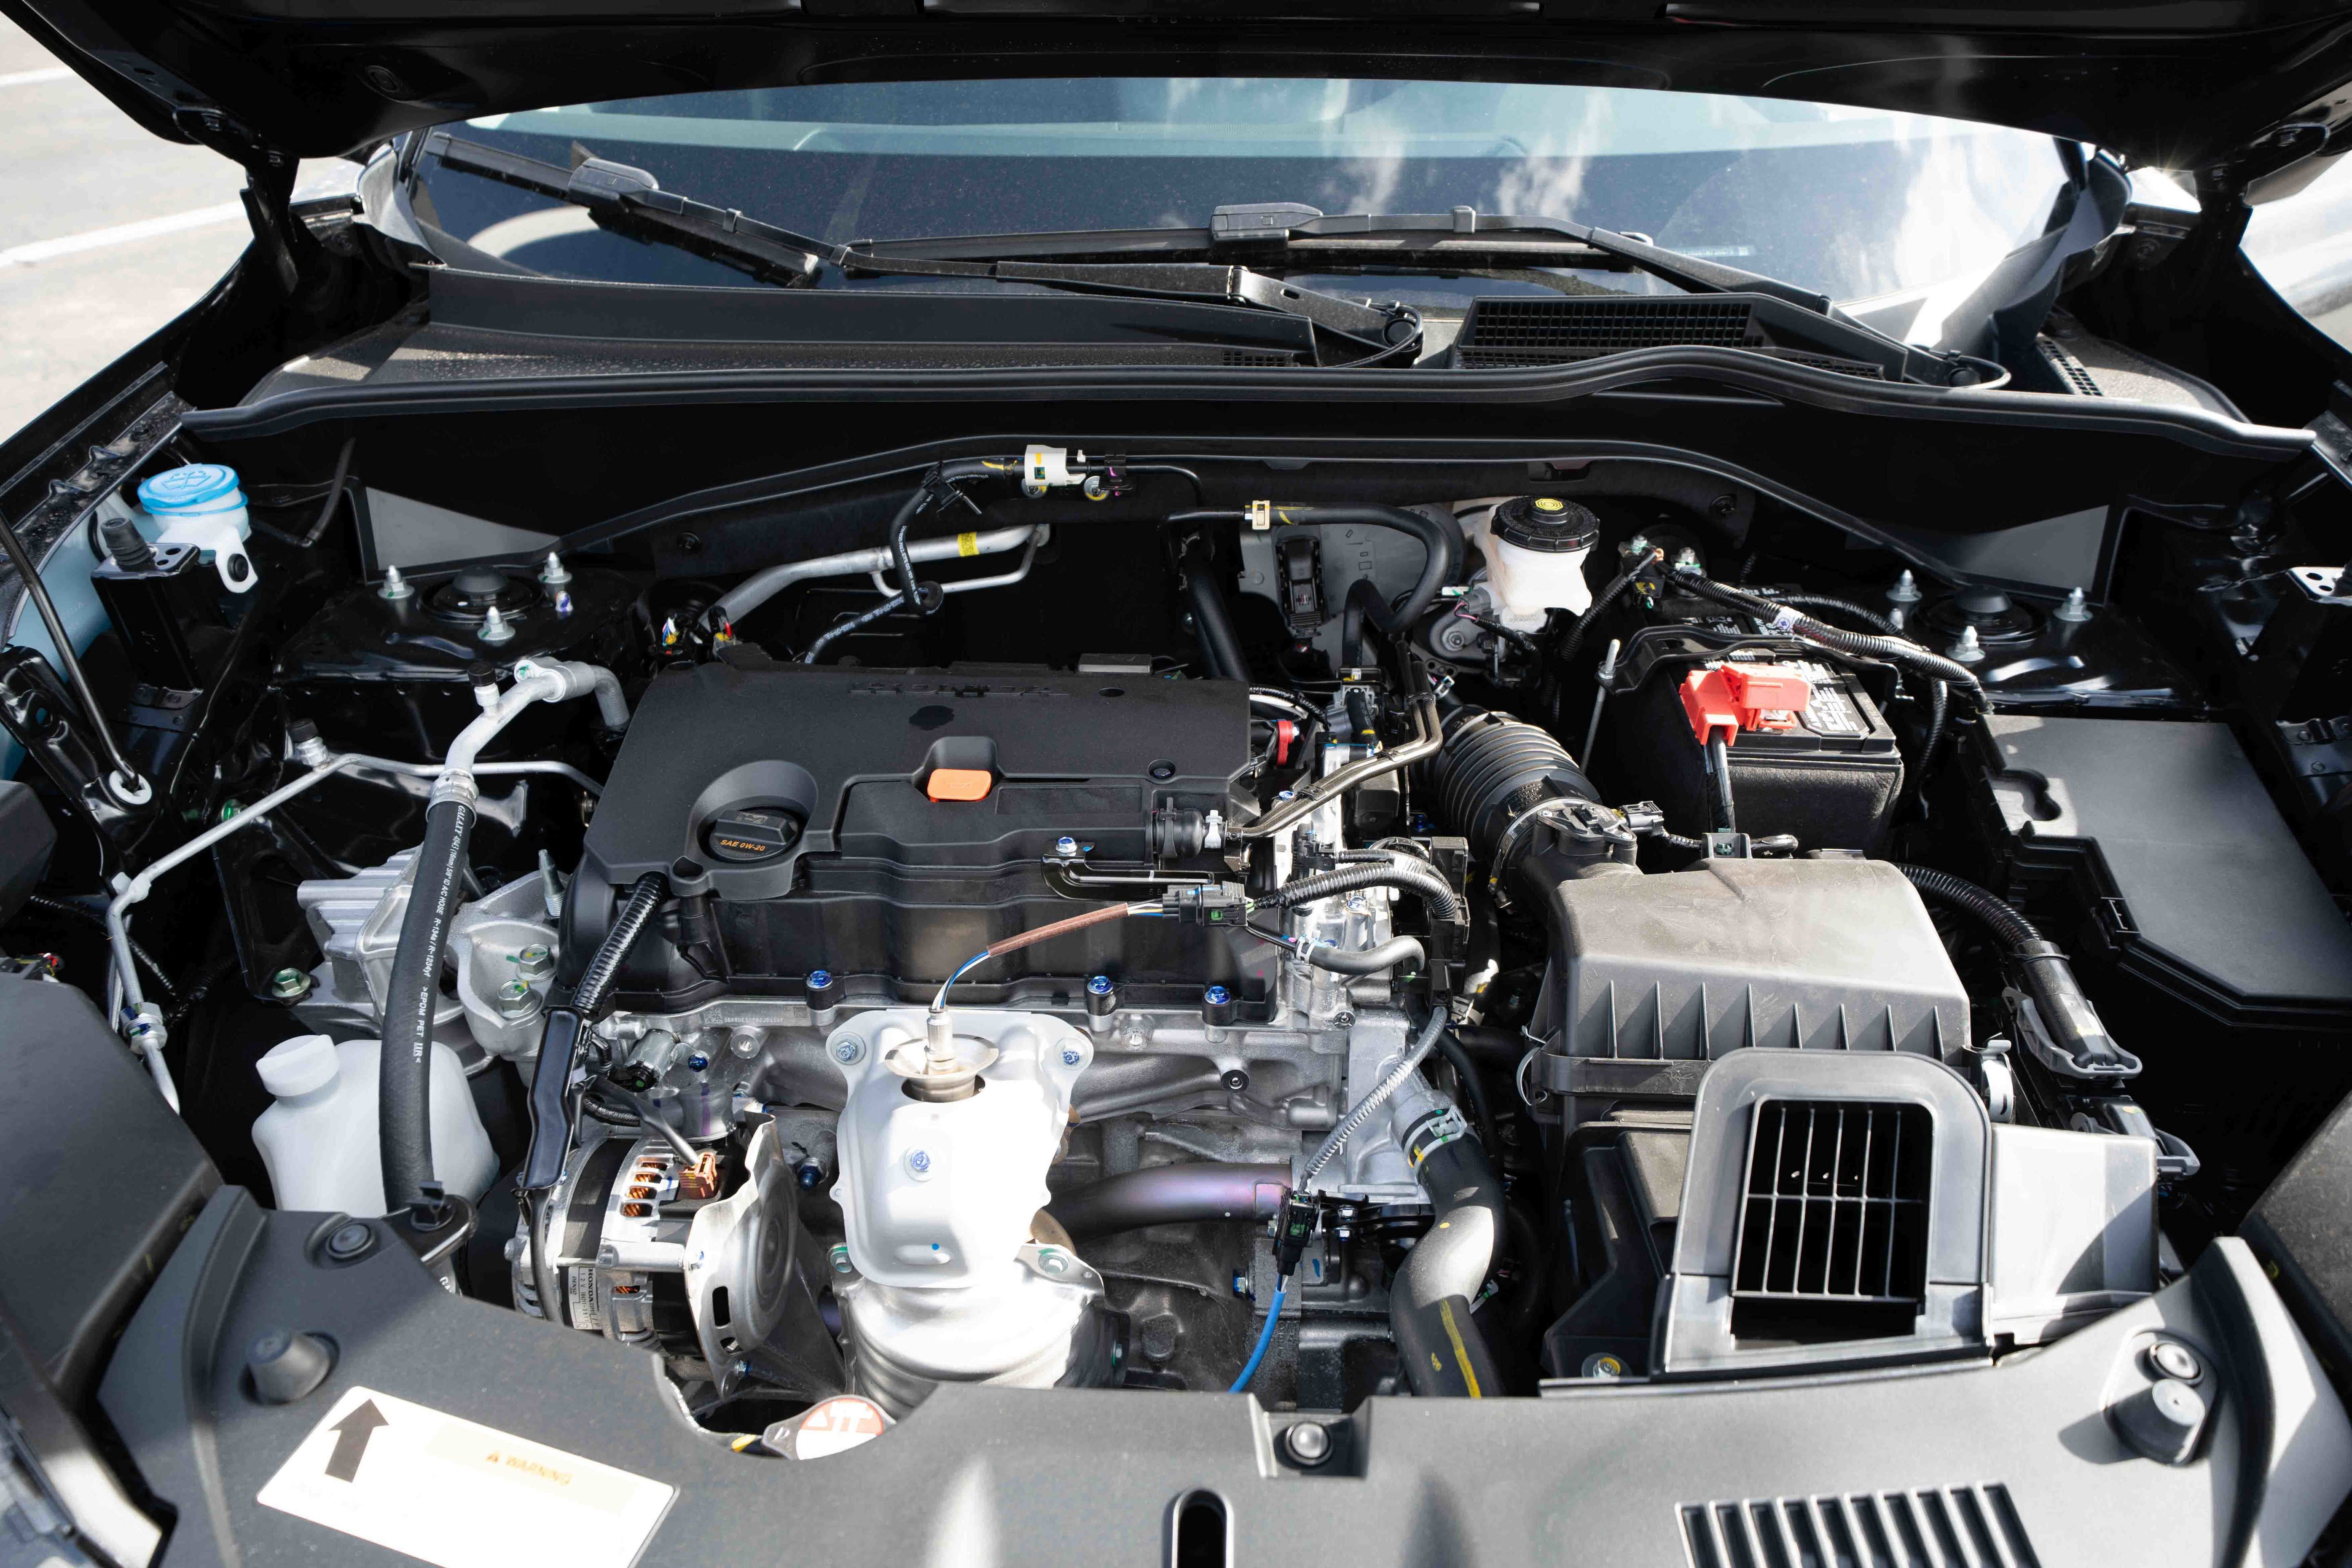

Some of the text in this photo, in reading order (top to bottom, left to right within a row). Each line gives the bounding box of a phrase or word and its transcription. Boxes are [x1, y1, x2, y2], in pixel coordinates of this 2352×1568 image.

[454, 805, 466, 836] GALAXY
[451, 835, 461, 850] 4843
[739, 843, 766, 851] 0W-20
[446, 849, 457, 868] (16mm)
[441, 885, 449, 896] A/C
[436, 896, 446, 915] HOSE
[430, 918, 441, 941] R-134a
[423, 945, 436, 977] R-1234yf
[416, 1020, 425, 1038] PET
[506, 1455, 572, 1486] WARNING
